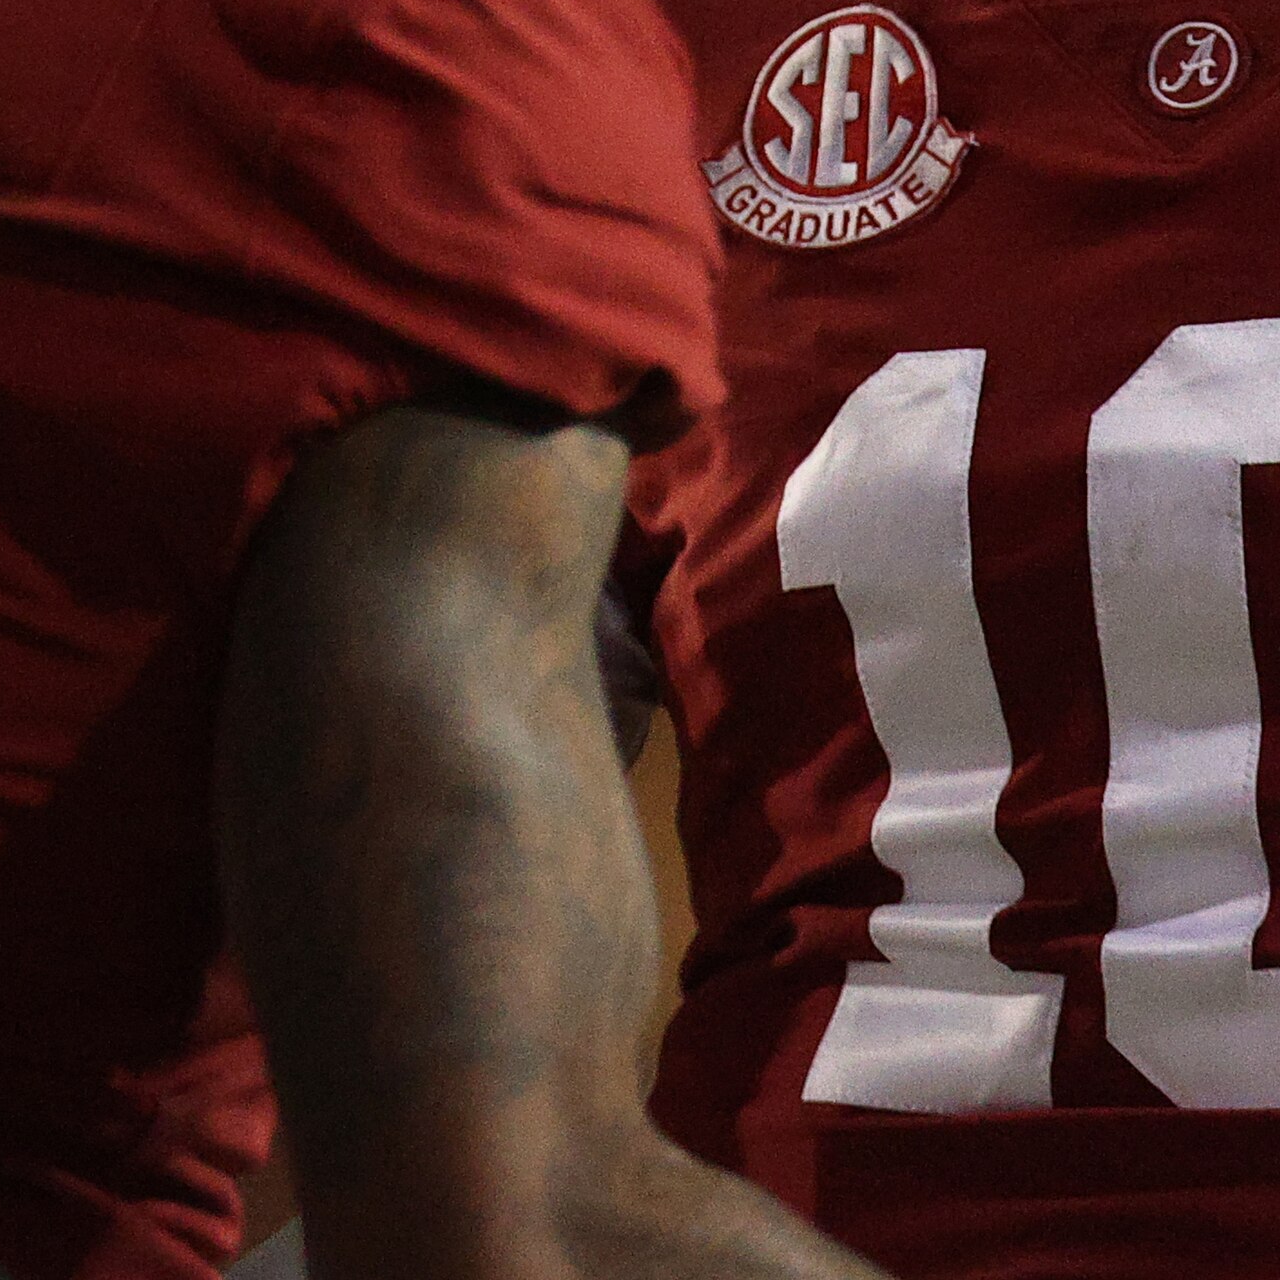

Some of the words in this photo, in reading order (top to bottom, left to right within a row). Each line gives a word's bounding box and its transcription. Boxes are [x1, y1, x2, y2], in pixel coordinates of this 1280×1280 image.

[1160, 32, 1219, 93] A
[763, 23, 917, 189] SEC
[724, 172, 932, 245] GRADUATE
